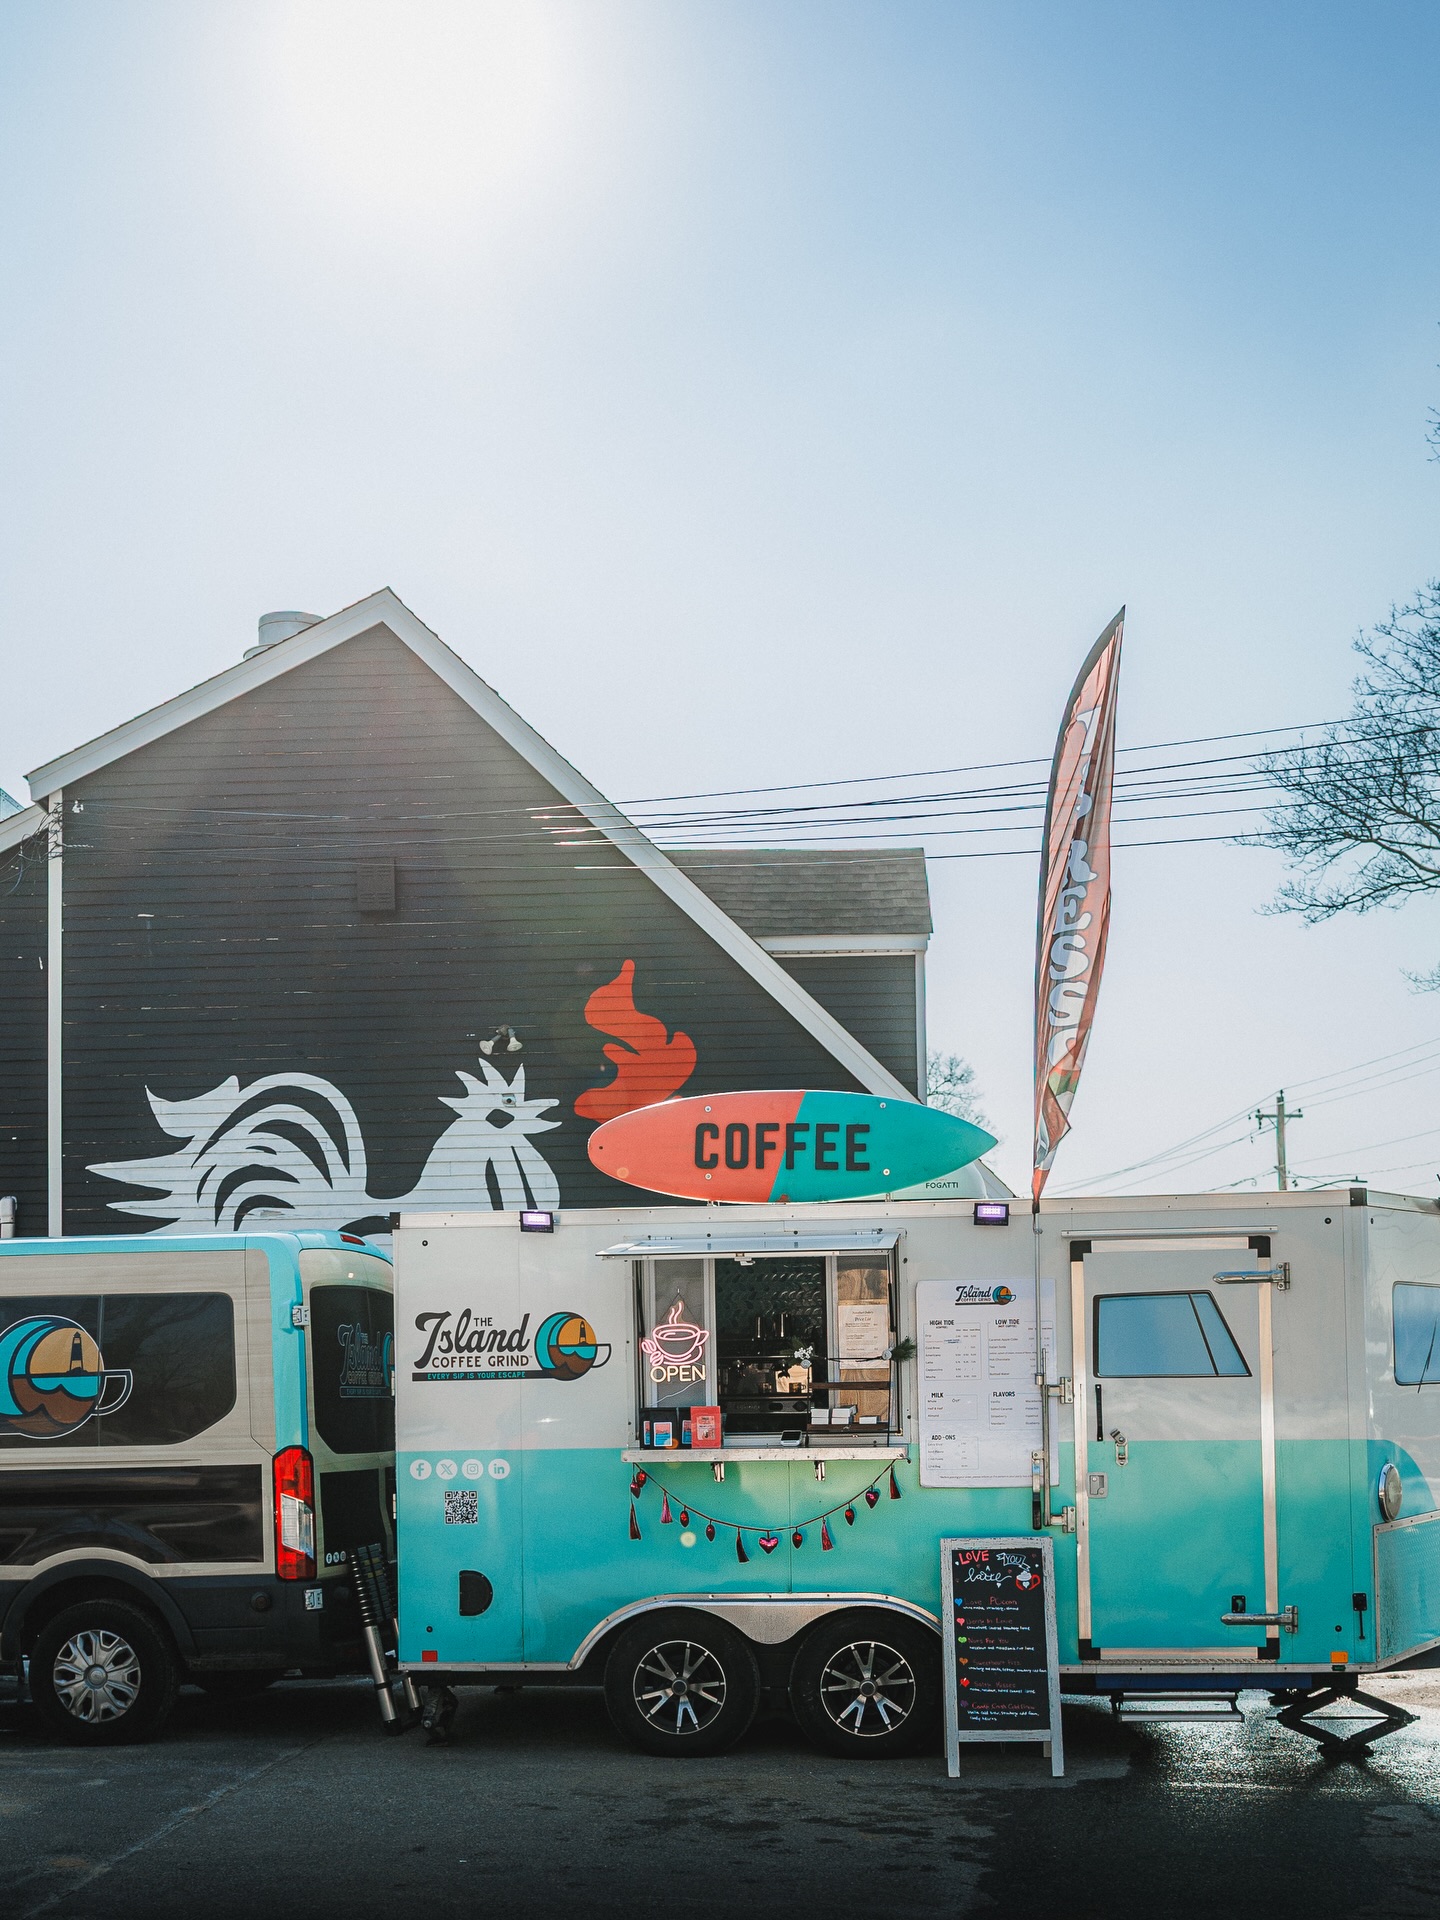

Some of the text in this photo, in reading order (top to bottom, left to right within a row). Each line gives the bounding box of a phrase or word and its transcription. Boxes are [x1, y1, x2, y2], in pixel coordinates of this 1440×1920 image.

[694, 1122, 870, 1171] COFFEE
[956, 1285, 992, 1302] Island
[474, 1317, 493, 1326] THE
[414, 1308, 530, 1369] Island
[338, 1323, 382, 1385] Island
[432, 1355, 530, 1368] COFFEE GRIND
[650, 1365, 706, 1382] OPEN
[958, 1550, 989, 1565] LOVE
[964, 1568, 1012, 1582] latte
